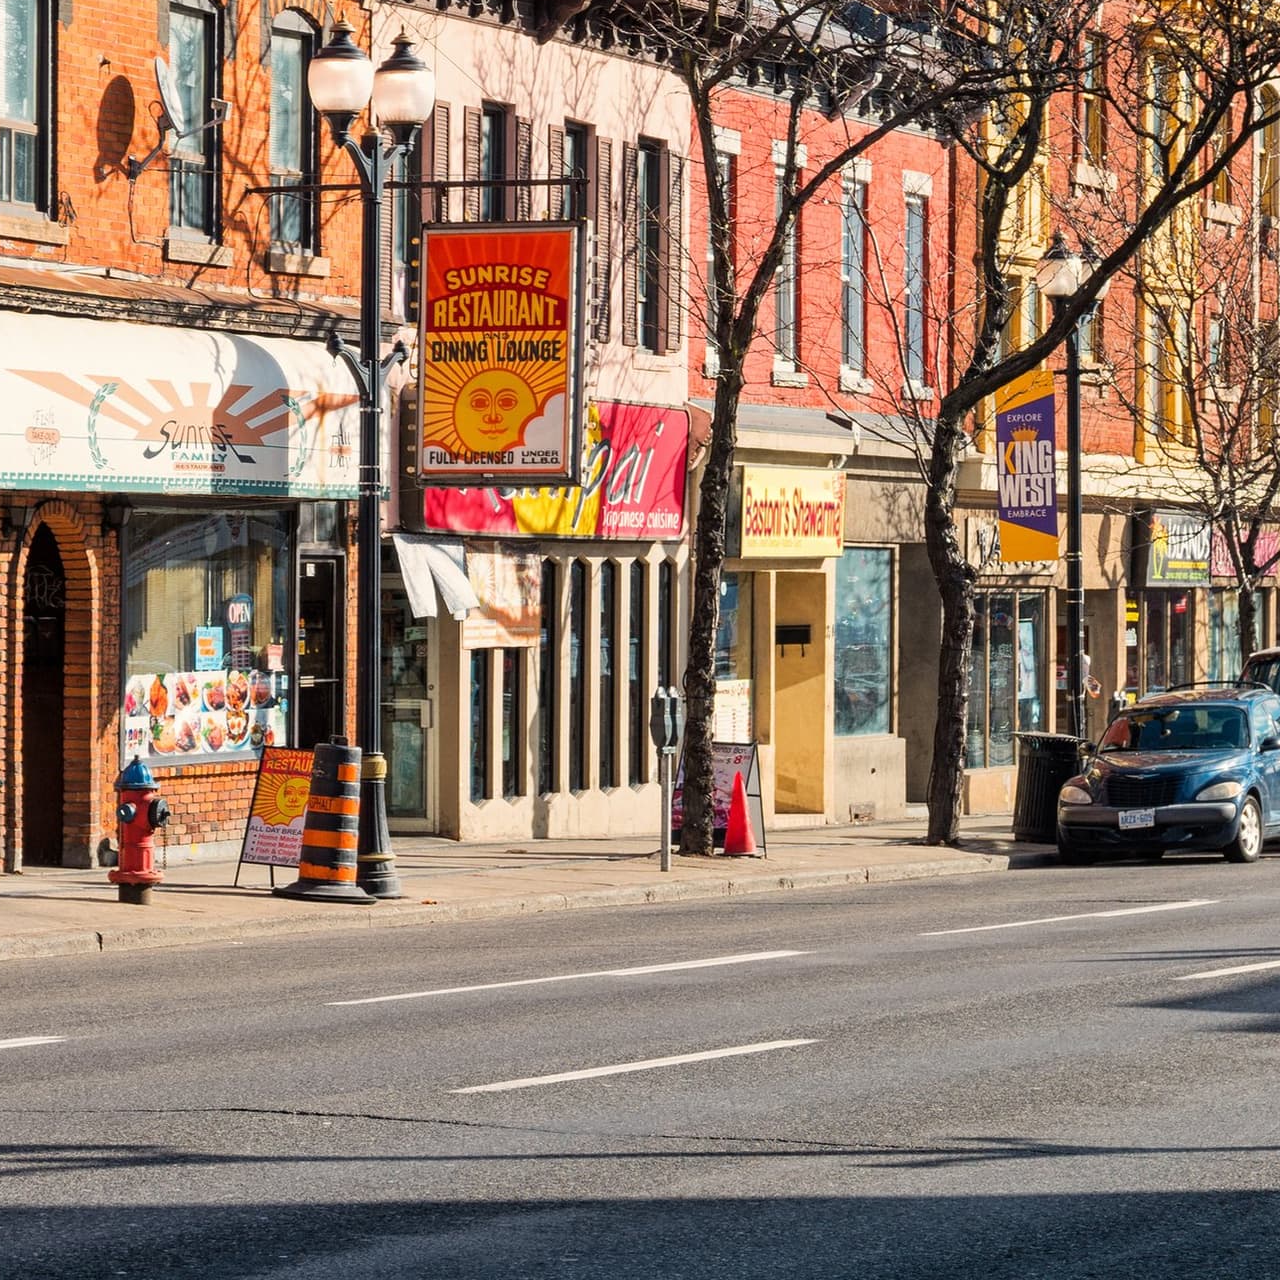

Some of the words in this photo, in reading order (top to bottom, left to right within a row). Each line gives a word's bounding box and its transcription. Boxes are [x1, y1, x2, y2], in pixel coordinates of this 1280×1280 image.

[446, 265, 550, 290] SUNRISE
[431, 340, 488, 363] DINING
[496, 340, 561, 363] LOUNGE
[1007, 413, 1043, 423] EXPLORE
[143, 419, 257, 464] Sunrise
[170, 451, 228, 463] FAMILY
[429, 451, 460, 465] FULLY
[463, 451, 514, 465] LICENSED
[998, 440, 1053, 475] KING
[999, 473, 1054, 508] WEST
[602, 507, 645, 529] Japanese
[646, 508, 679, 529] cuisine
[1007, 509, 1047, 518] EMBRACE
[229, 603, 251, 624] OPEN
